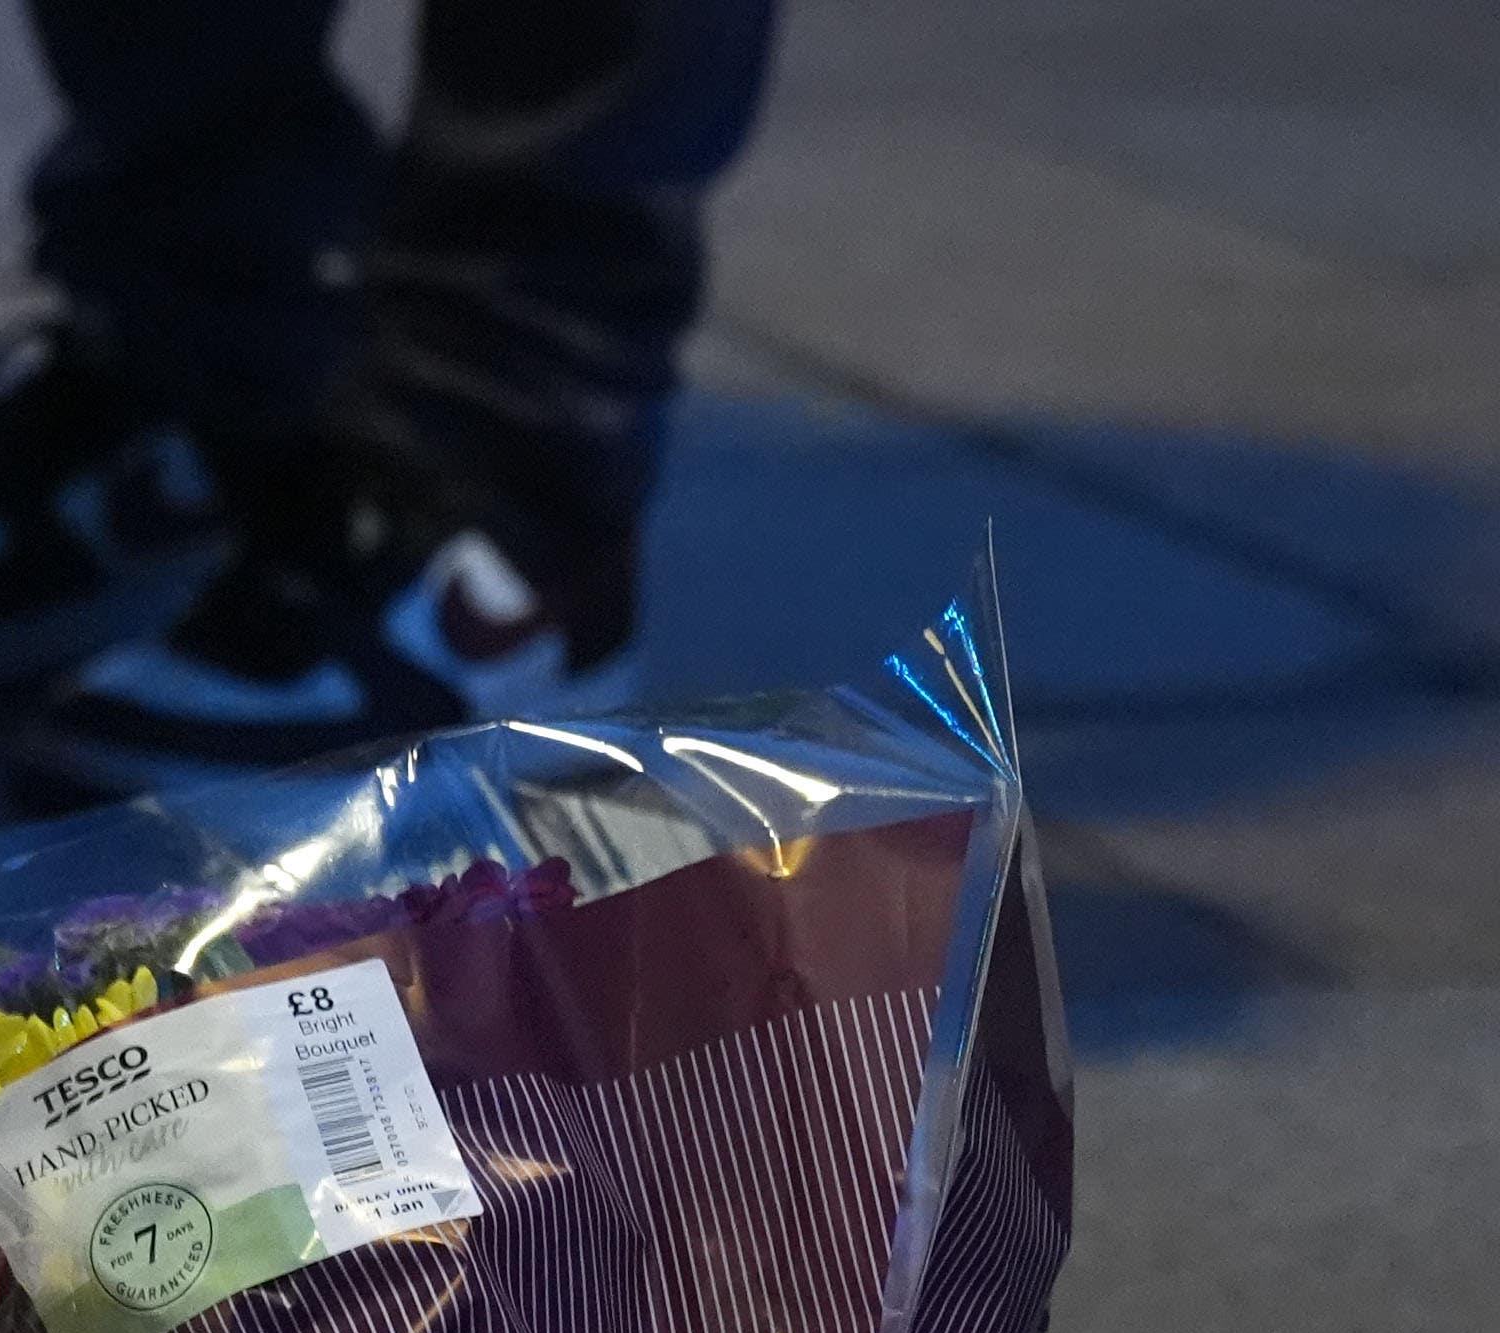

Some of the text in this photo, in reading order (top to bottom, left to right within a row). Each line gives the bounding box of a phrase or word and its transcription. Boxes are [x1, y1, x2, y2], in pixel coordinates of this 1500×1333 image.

[287, 986, 334, 1018] £8
[298, 1011, 357, 1037] Bright
[295, 1030, 379, 1061] Bouquet
[33, 1045, 149, 1115] TESCO
[15, 1078, 210, 1188] HAND-PICKED
[99, 1190, 185, 1247] FRESHNESS
[390, 1199, 425, 1218] Jan
[110, 1250, 134, 1271] FOR
[133, 1222, 157, 1265] 7
[116, 1240, 204, 1301] GUARANTEED
